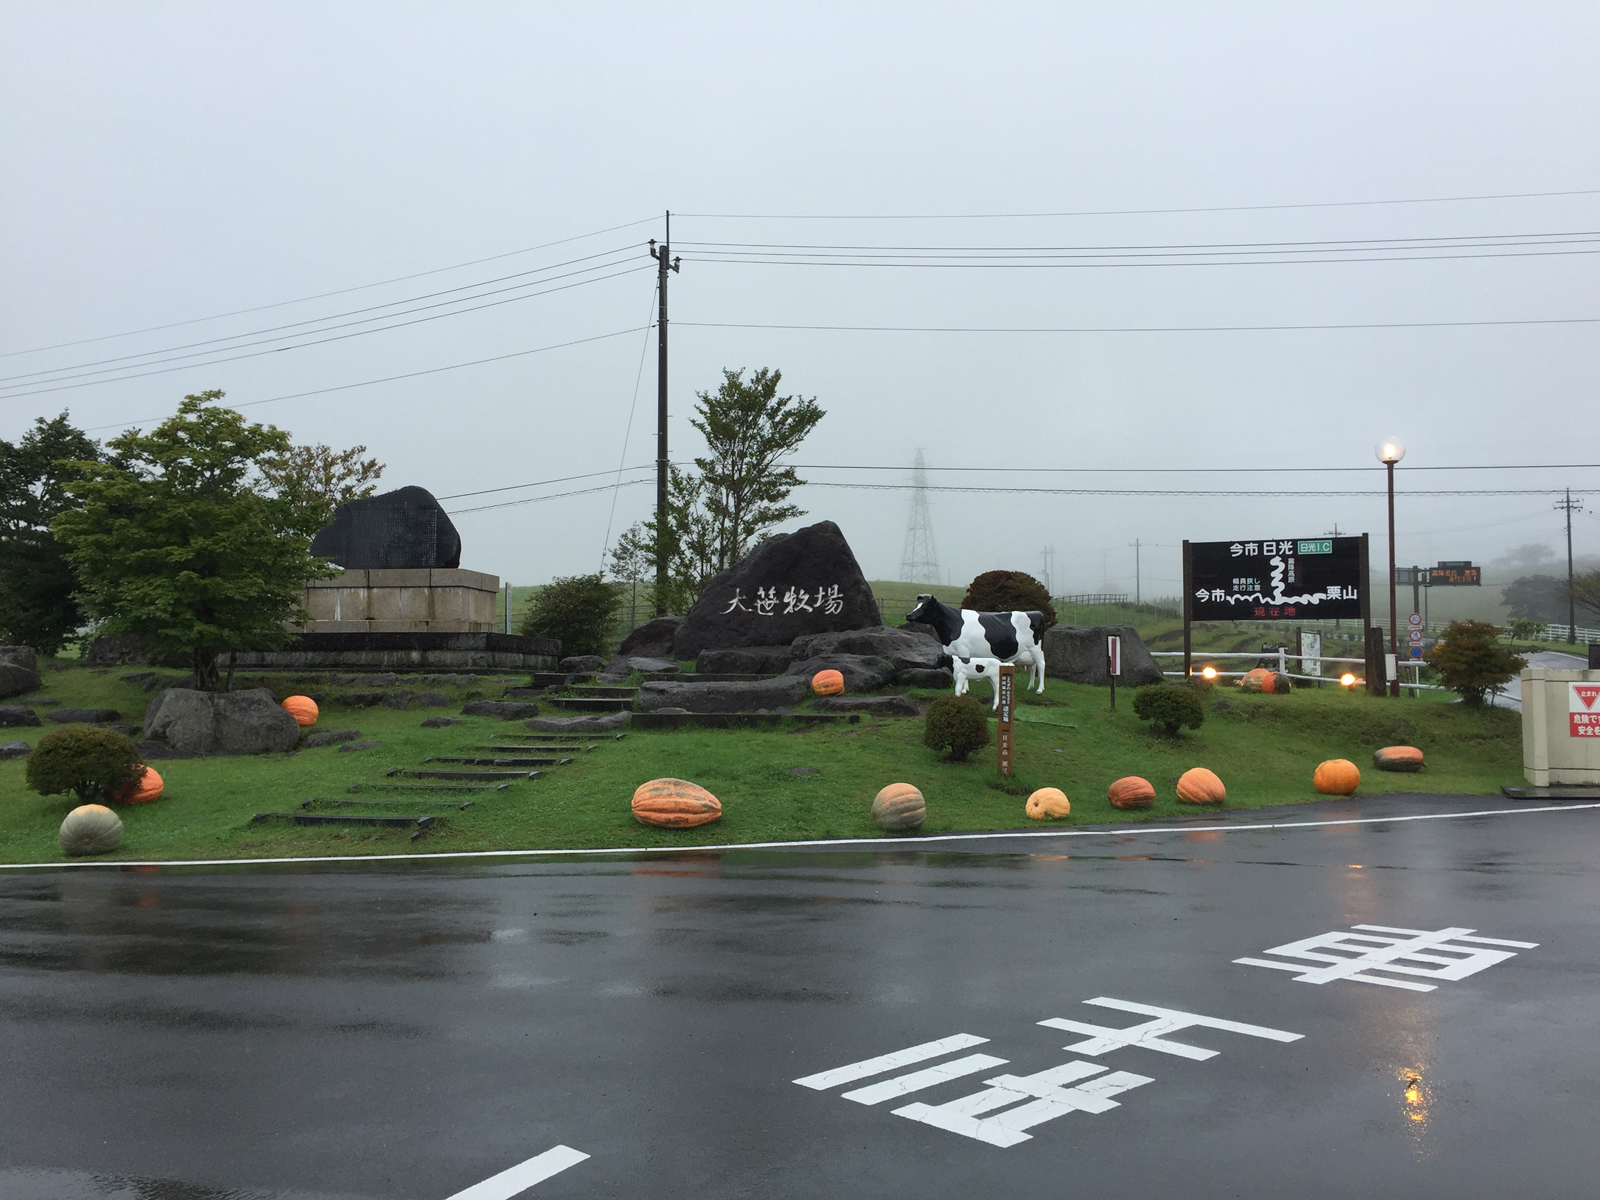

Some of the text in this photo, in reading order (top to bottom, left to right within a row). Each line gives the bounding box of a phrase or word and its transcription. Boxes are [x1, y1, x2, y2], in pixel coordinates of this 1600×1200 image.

[1230, 541, 1293, 557] 今市 日光
[719, 583, 844, 616] 大笹牧場
[1195, 588, 1225, 603] 今市
[1326, 585, 1358, 600] 栗山
[1254, 606, 1296, 617] 現在地
